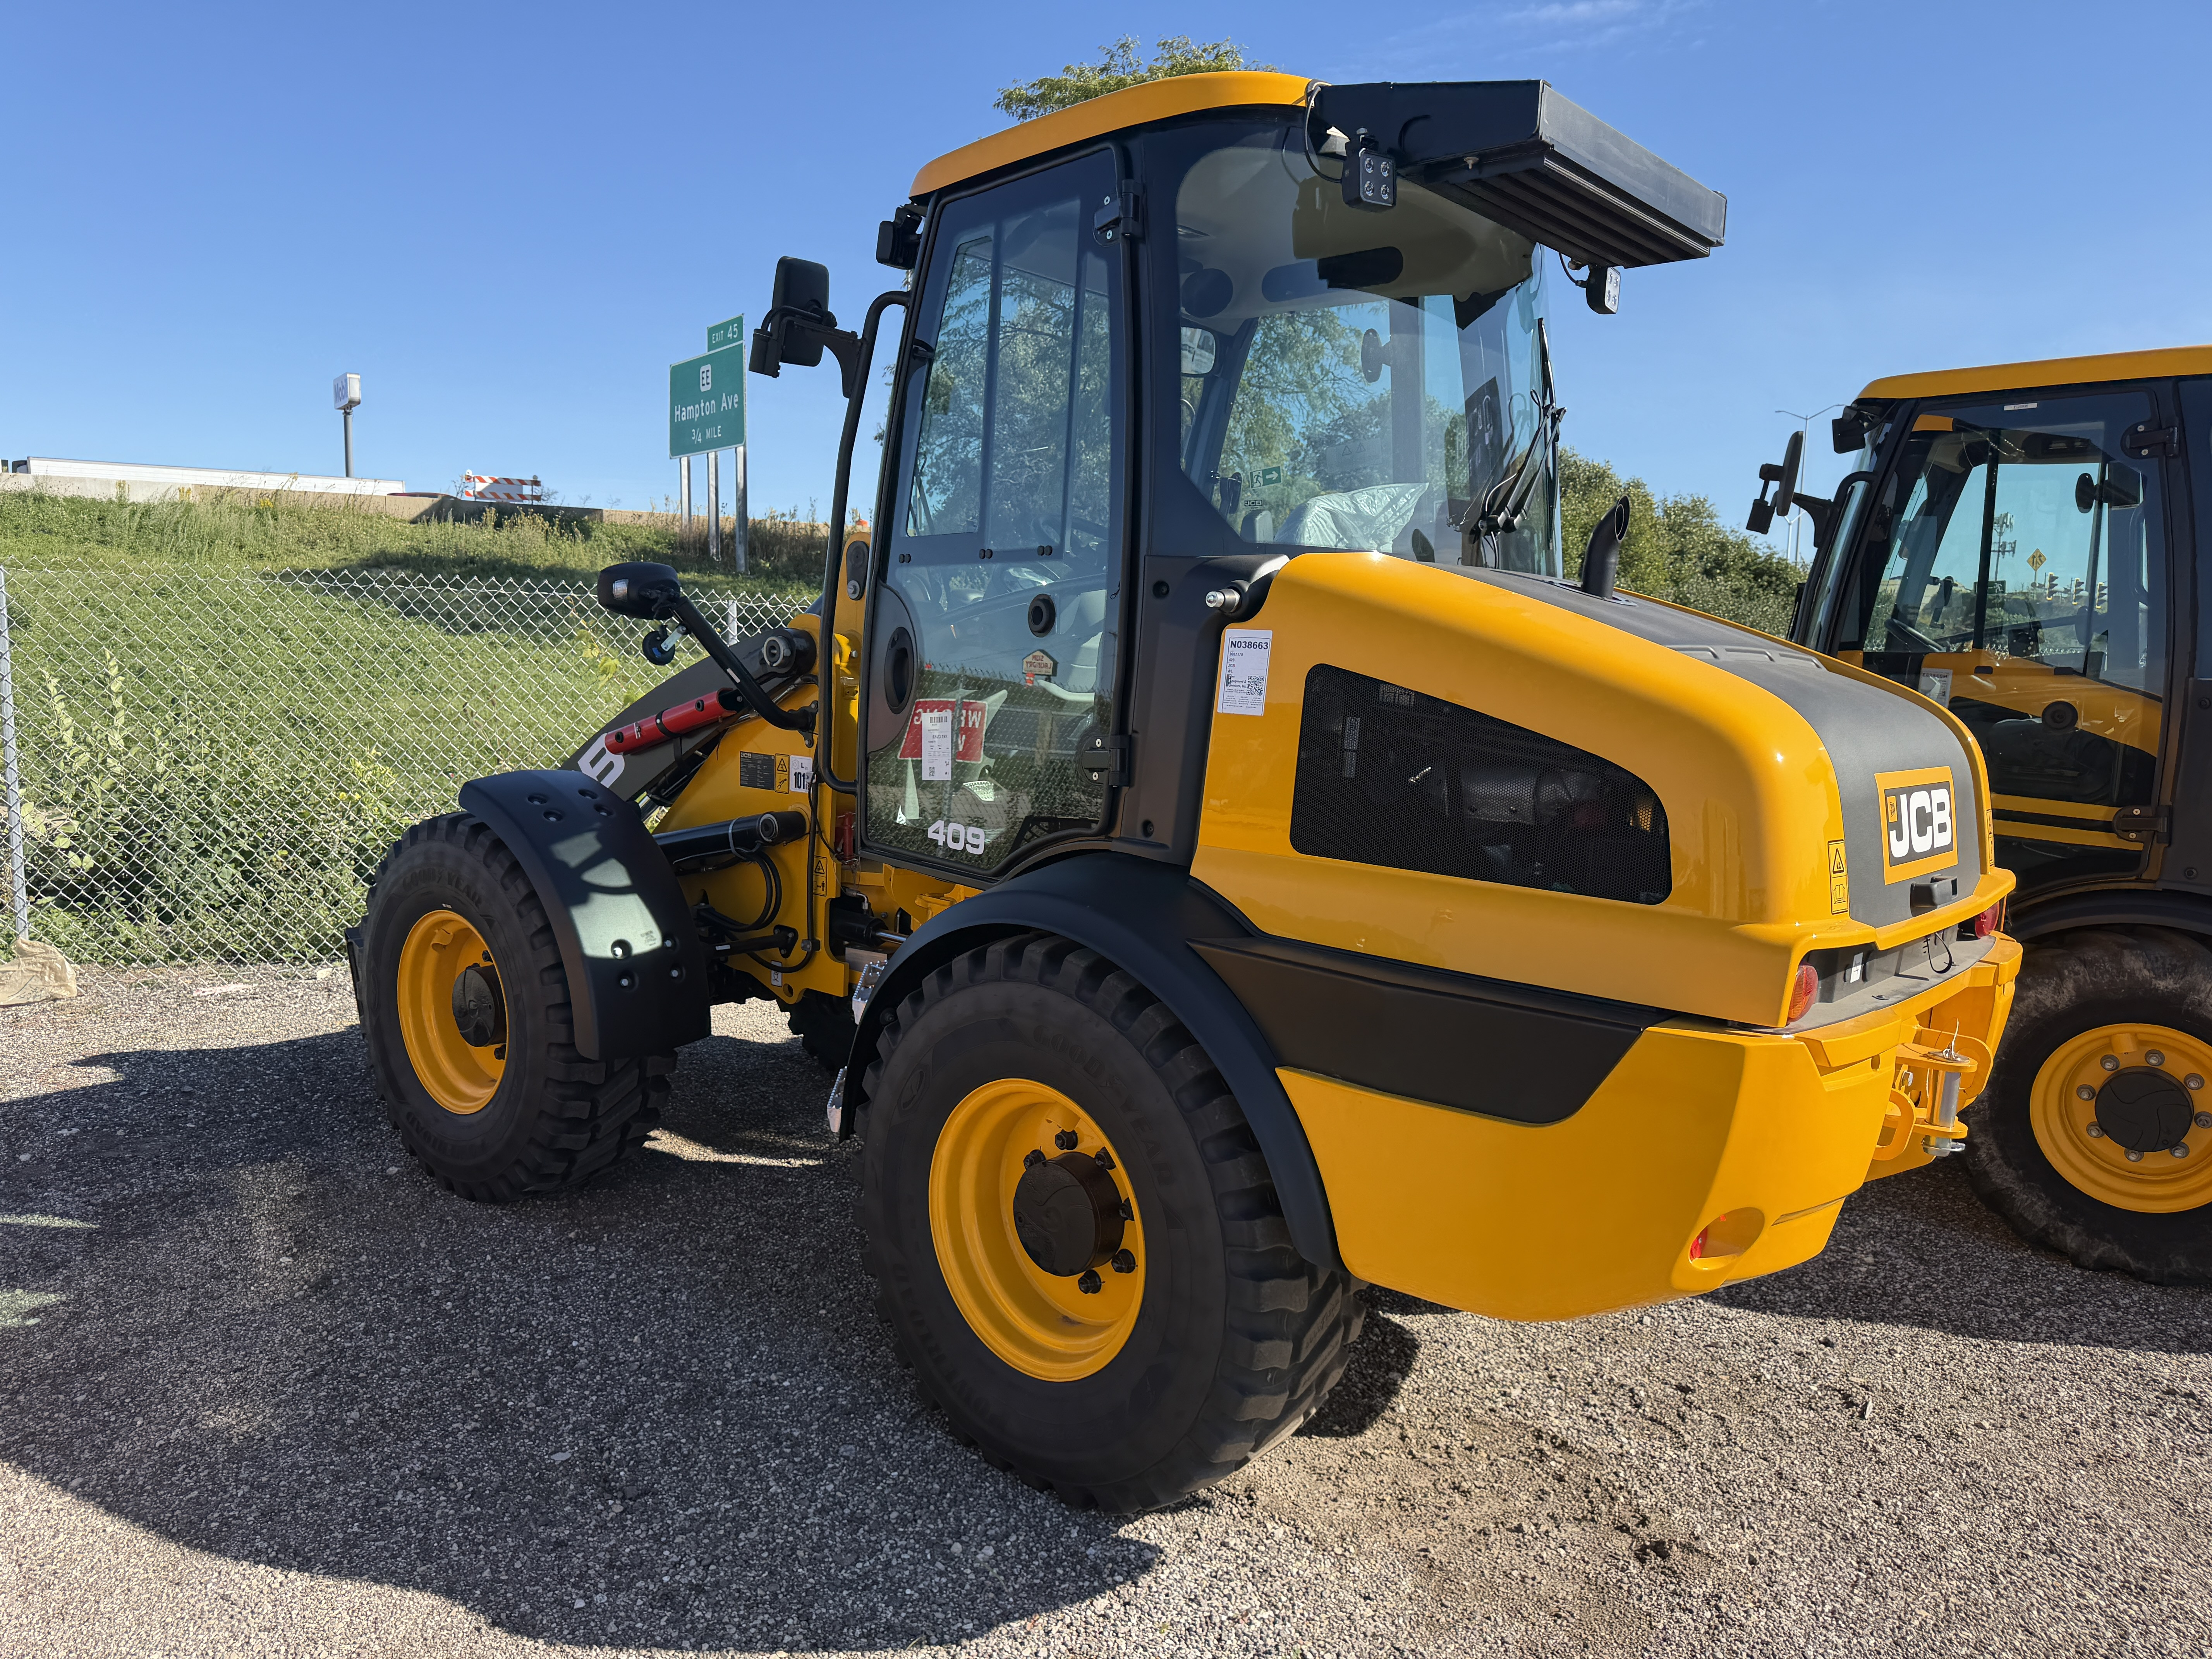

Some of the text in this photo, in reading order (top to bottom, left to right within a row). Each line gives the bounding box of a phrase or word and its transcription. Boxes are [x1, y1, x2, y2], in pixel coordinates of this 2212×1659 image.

[712, 323, 738, 344] EXIT 45
[701, 369, 710, 386] EE
[675, 393, 738, 422] Hampton Ave
[706, 425, 721, 439] MILE
[1230, 641, 1268, 649] N038663
[794, 771, 805, 790] 101
[1890, 788, 1952, 858] JCB
[927, 820, 985, 855] 409
[403, 867, 482, 908] GOODYEAR
[1034, 1025, 1175, 1187] GOODYEAR
